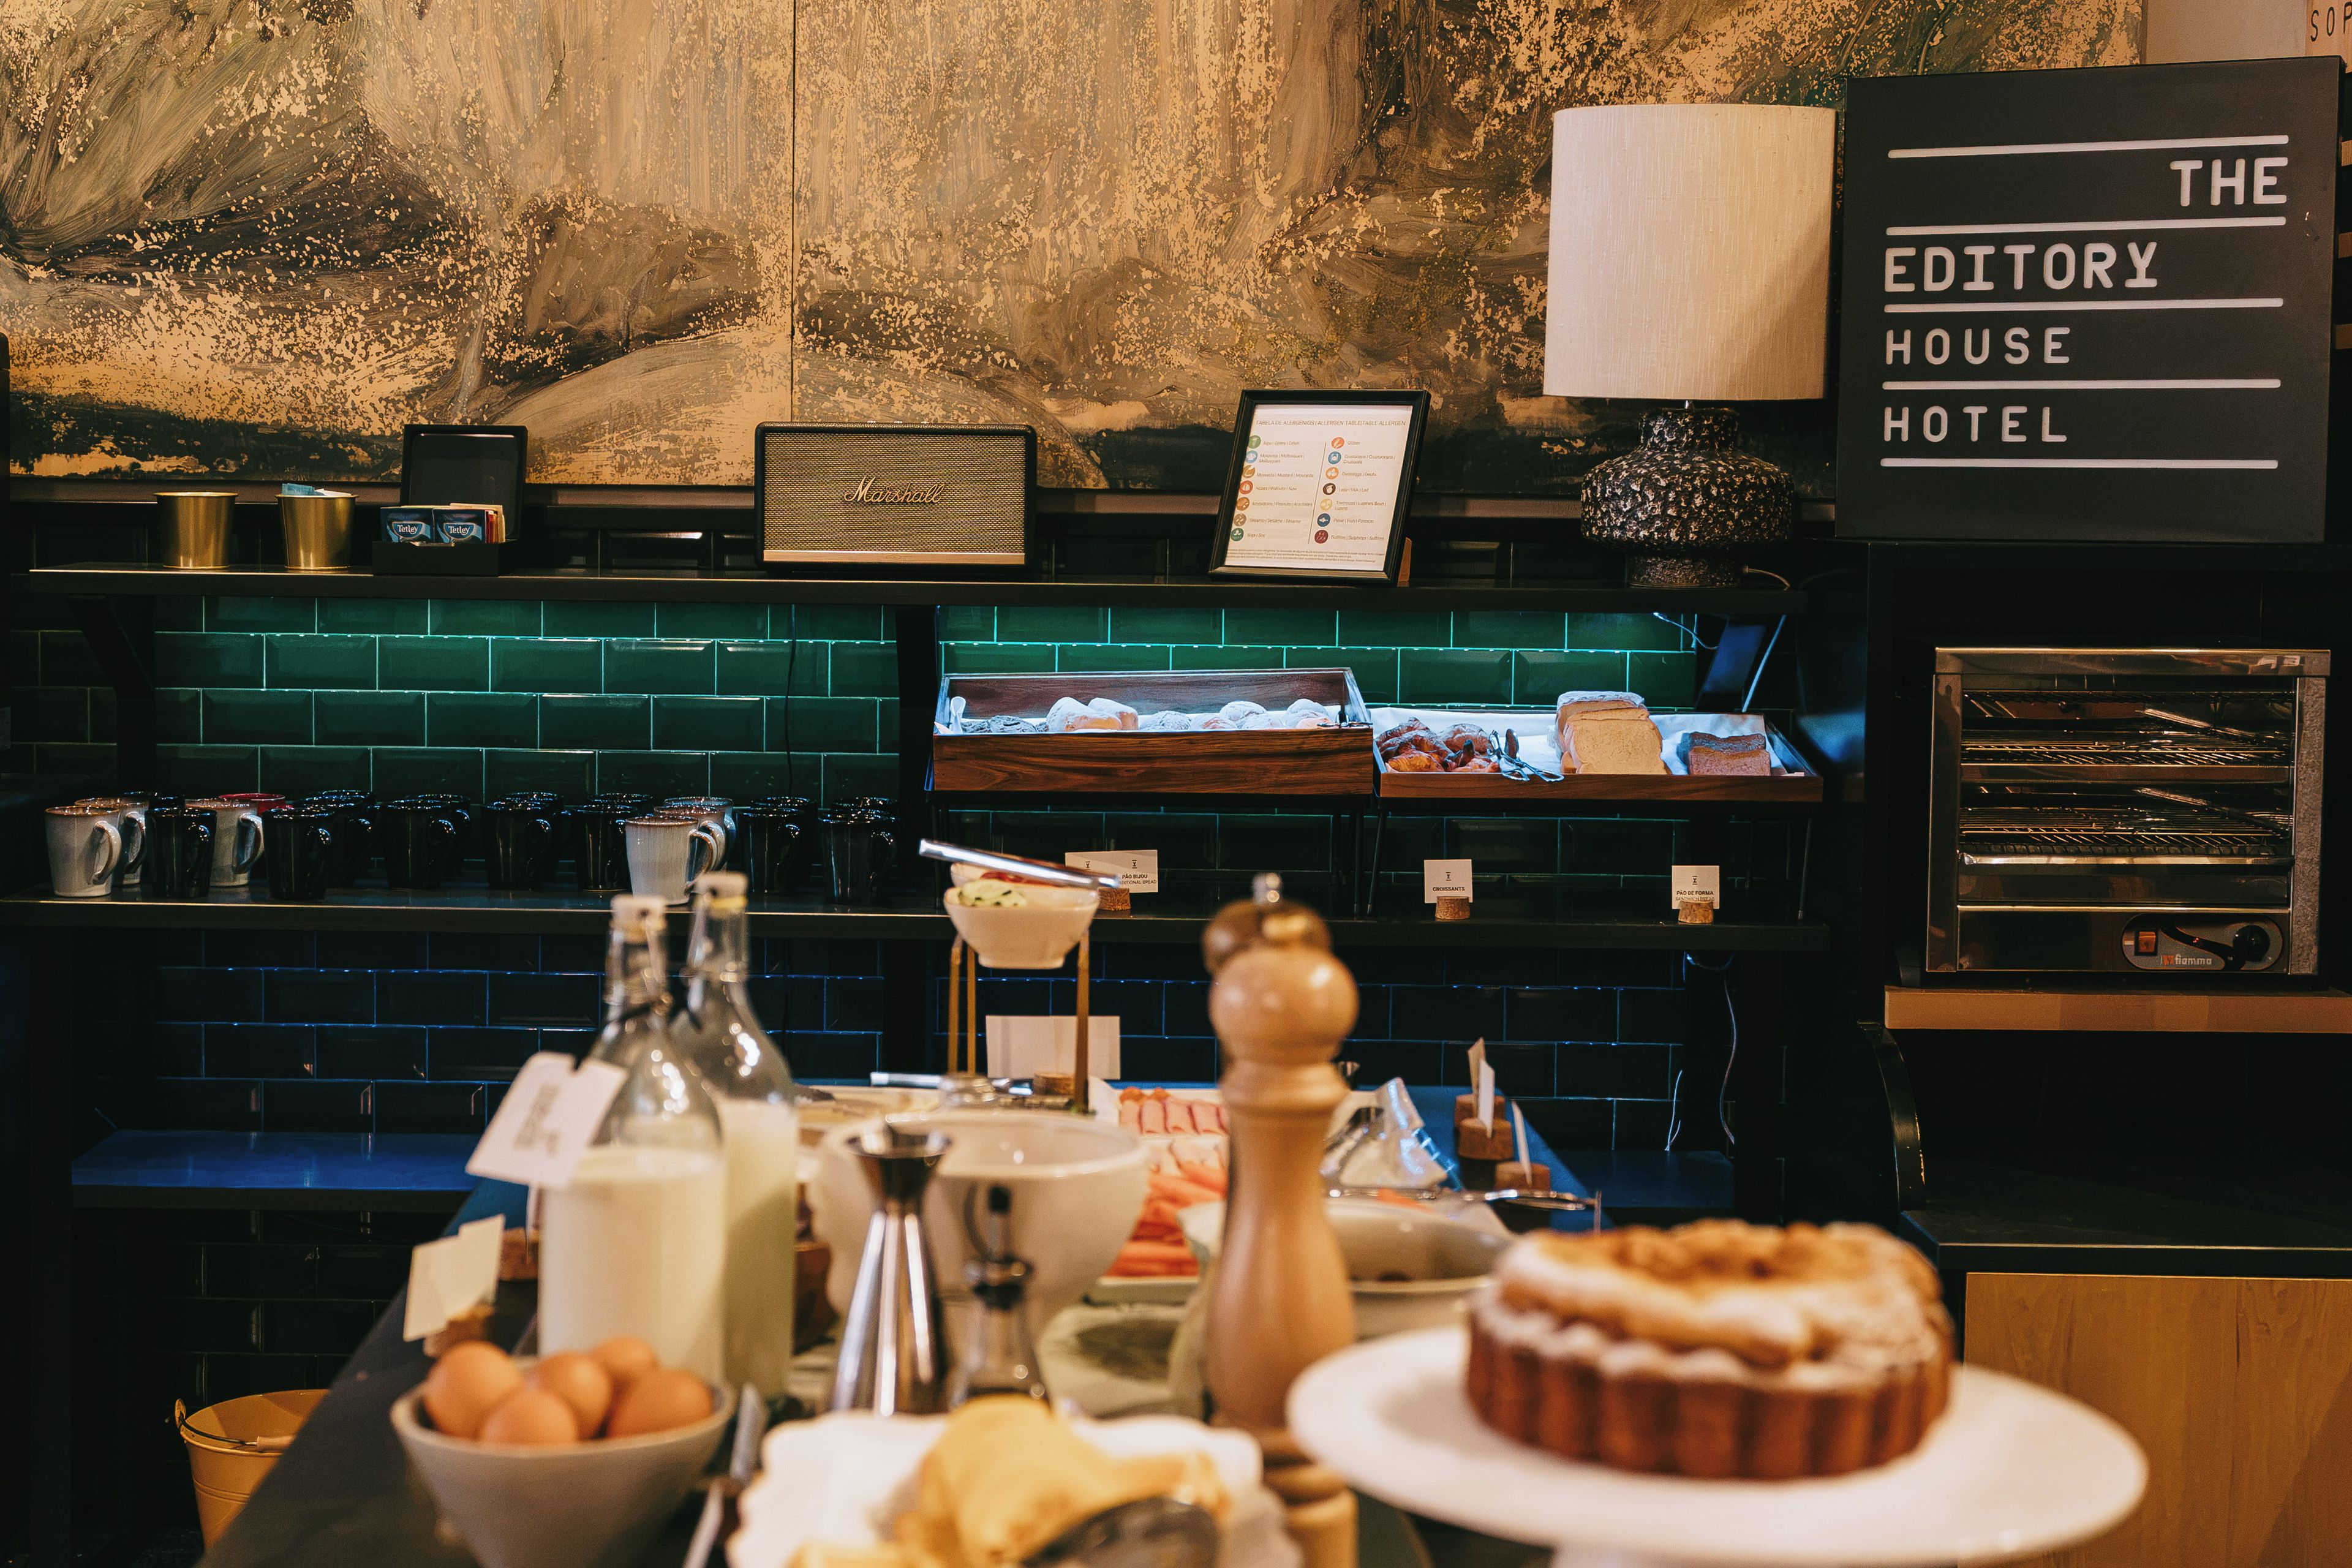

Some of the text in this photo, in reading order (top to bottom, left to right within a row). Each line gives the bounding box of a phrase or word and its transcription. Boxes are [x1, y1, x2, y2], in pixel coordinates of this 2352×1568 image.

[2310, 2, 2352, 42] SOP
[2170, 157, 2289, 206] THE
[1884, 241, 2158, 293] EDITORY
[1885, 327, 2071, 365] HOUSE
[1883, 405, 2067, 443] HOTEL
[844, 477, 944, 503] Marshall
[397, 524, 418, 535] Tetley
[448, 526, 470, 536] Tetley
